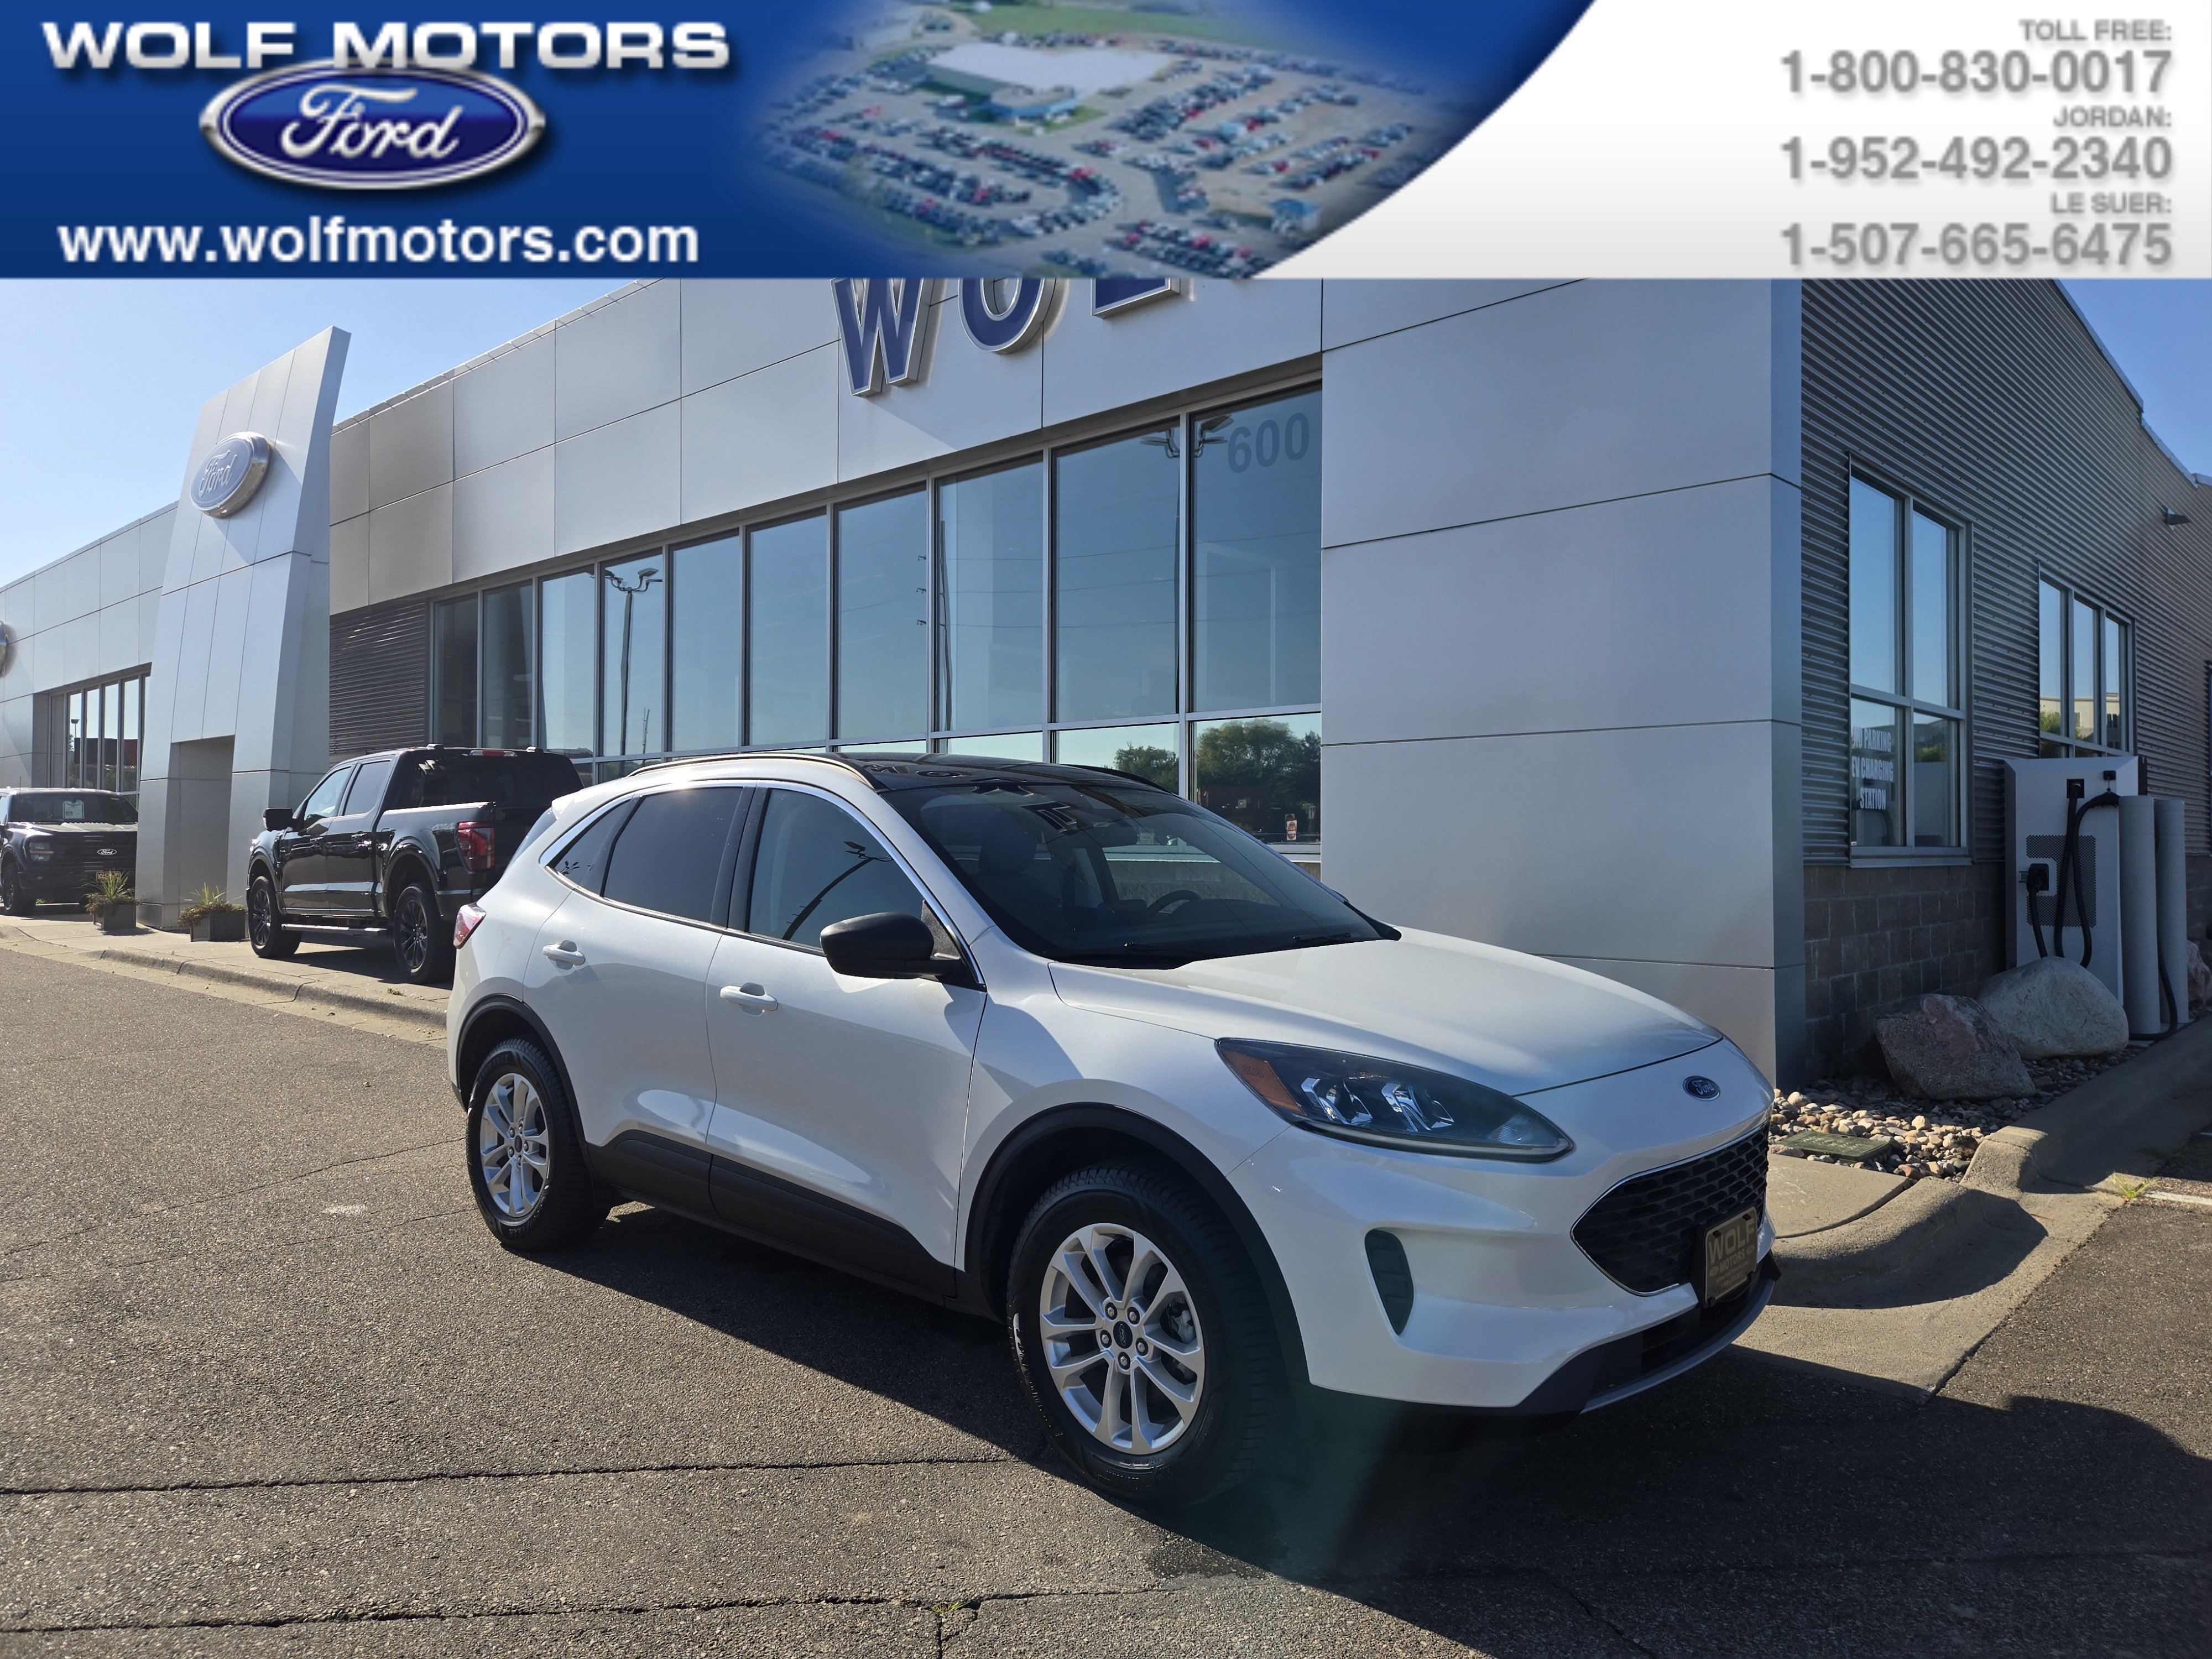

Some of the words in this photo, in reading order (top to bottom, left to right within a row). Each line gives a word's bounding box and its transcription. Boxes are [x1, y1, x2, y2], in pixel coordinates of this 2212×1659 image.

[1227, 413, 1310, 474] 600
[199, 449, 238, 498] Ford
[1853, 726, 1863, 748] NO
[1864, 727, 1891, 753] PARKING
[1851, 755, 1860, 778] EV
[1861, 757, 1893, 782] CHARGING
[1860, 787, 1886, 810] STATION
[1692, 1079, 1714, 1095] Ford
[1708, 1217, 1755, 1265] WOLF
[1720, 1248, 1745, 1273] MOTORS
